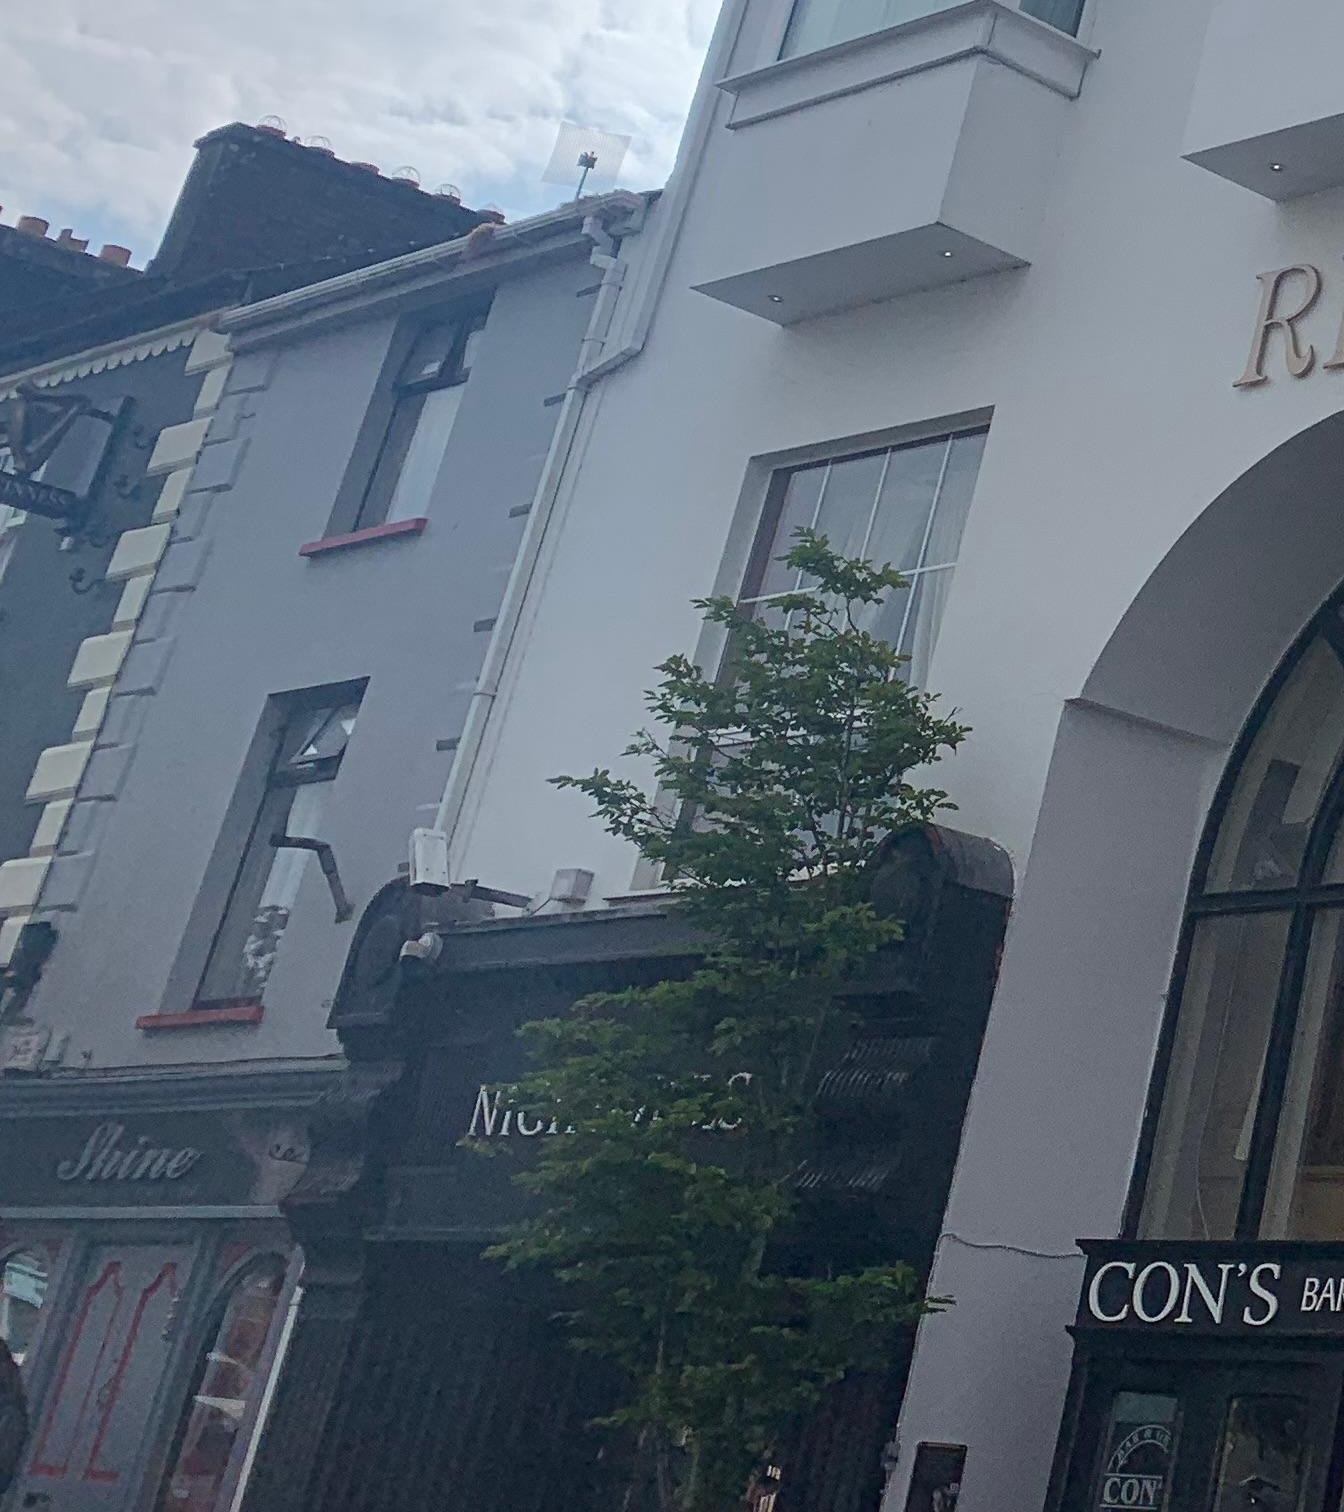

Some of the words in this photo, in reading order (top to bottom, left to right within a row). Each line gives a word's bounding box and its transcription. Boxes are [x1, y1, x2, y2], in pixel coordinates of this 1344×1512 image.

[56, 1122, 205, 1180] Shine
[1088, 1261, 1282, 1326] CON'S
[1103, 1476, 1162, 1506] CON'
